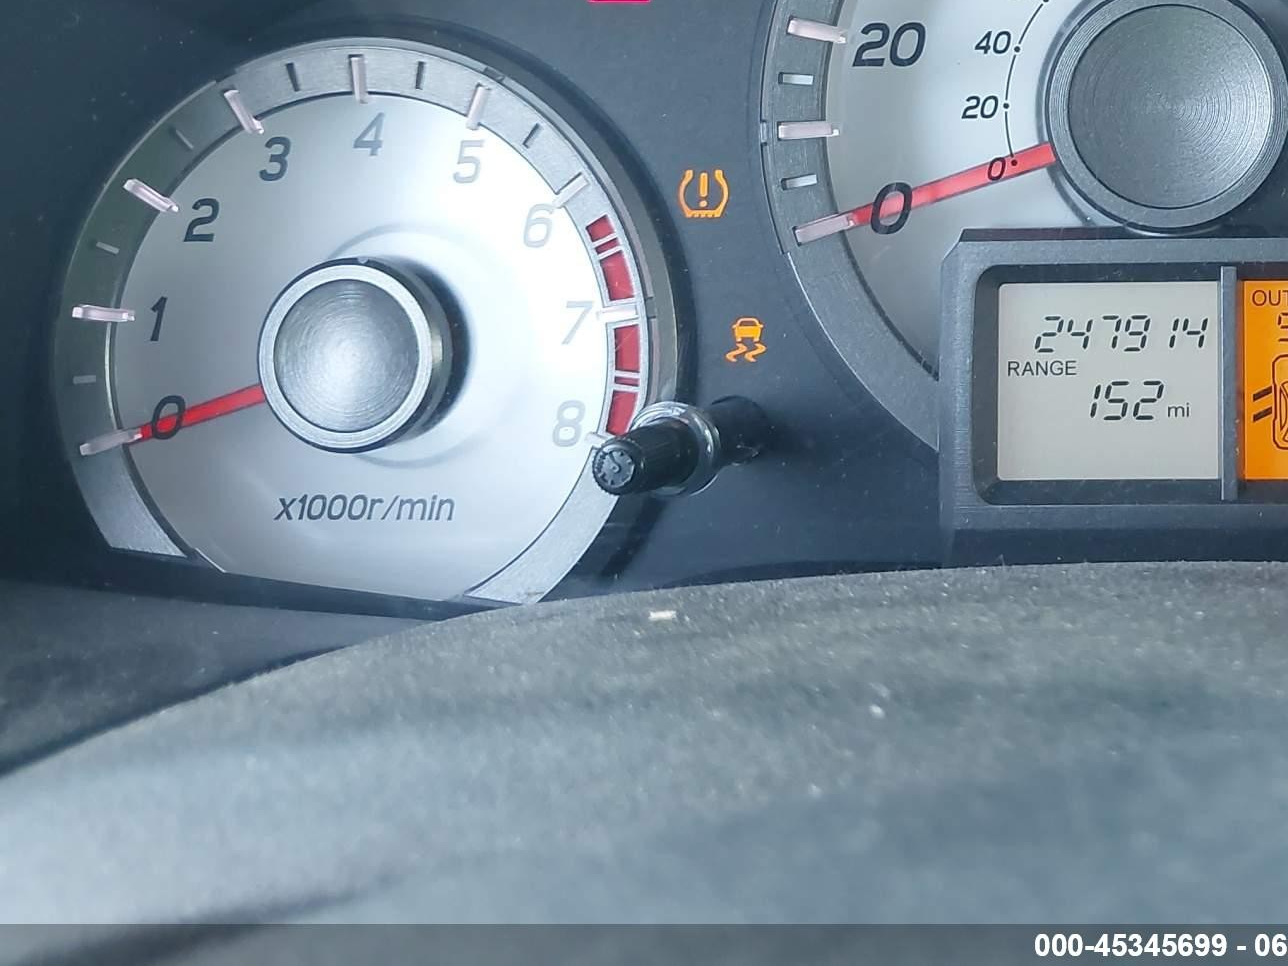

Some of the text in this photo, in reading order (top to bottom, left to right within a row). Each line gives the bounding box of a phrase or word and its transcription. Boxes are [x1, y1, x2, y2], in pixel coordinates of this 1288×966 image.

[853, 21, 926, 68] 20
[974, 30, 1011, 55] 40
[961, 94, 999, 120] 20
[353, 112, 385, 156] 4
[259, 136, 292, 182] 3
[453, 139, 484, 184] 5
[988, 156, 1007, 181] 0
[183, 198, 220, 243] 2
[523, 203, 555, 248] 6
[869, 182, 913, 235] 0
[149, 296, 168, 343] 1
[561, 301, 593, 345] 7
[1035, 315, 1209, 353] 247914
[1007, 361, 1078, 376] RANGE
[150, 395, 187, 441] 0
[1090, 380, 1190, 421] 152 mi
[552, 400, 586, 447] 8
[274, 493, 455, 523] x1000r/min
